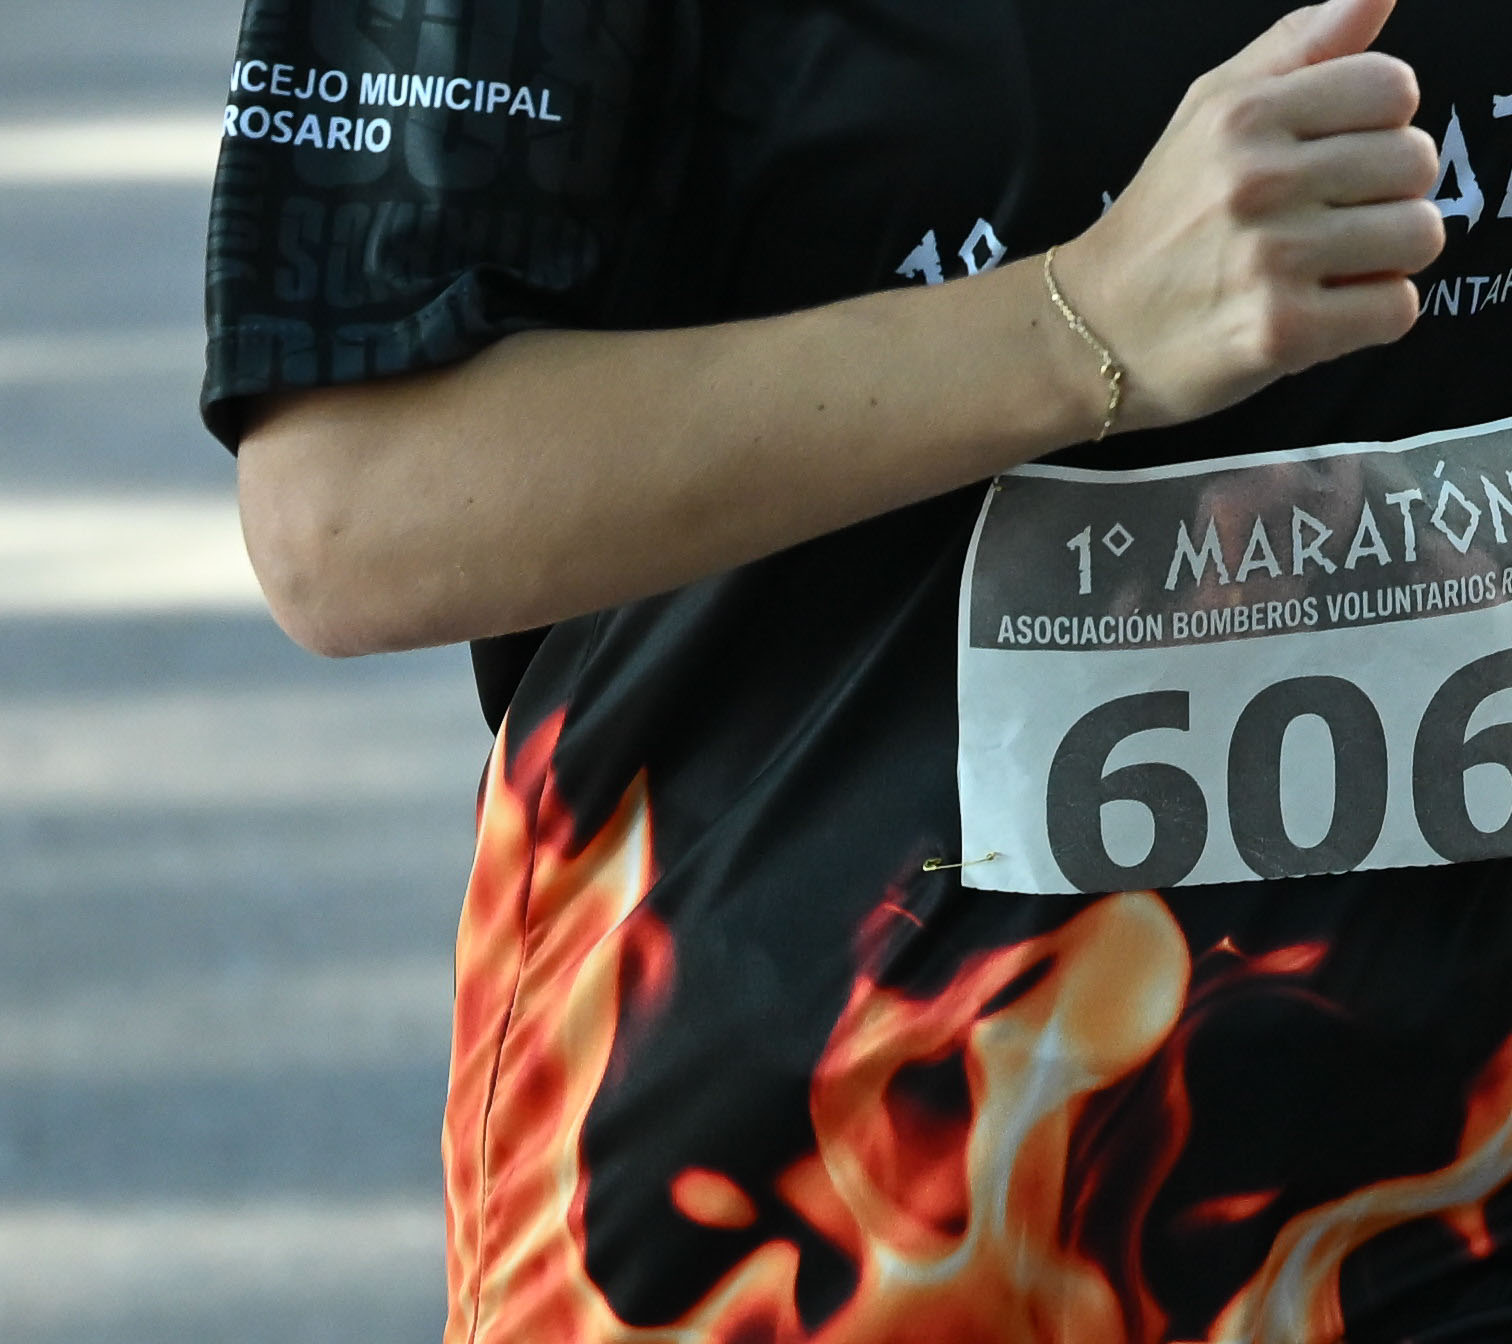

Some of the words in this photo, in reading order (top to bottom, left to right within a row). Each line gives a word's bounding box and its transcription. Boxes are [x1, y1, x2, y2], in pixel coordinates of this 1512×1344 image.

[359, 72, 562, 121] MUNICIPAL
[222, 104, 392, 153] ROSARIO
[996, 607, 1163, 644] ASOCIACIÓN
[1172, 597, 1319, 640] BOMBEROS
[1326, 571, 1497, 624] VOLUNTARIOS
